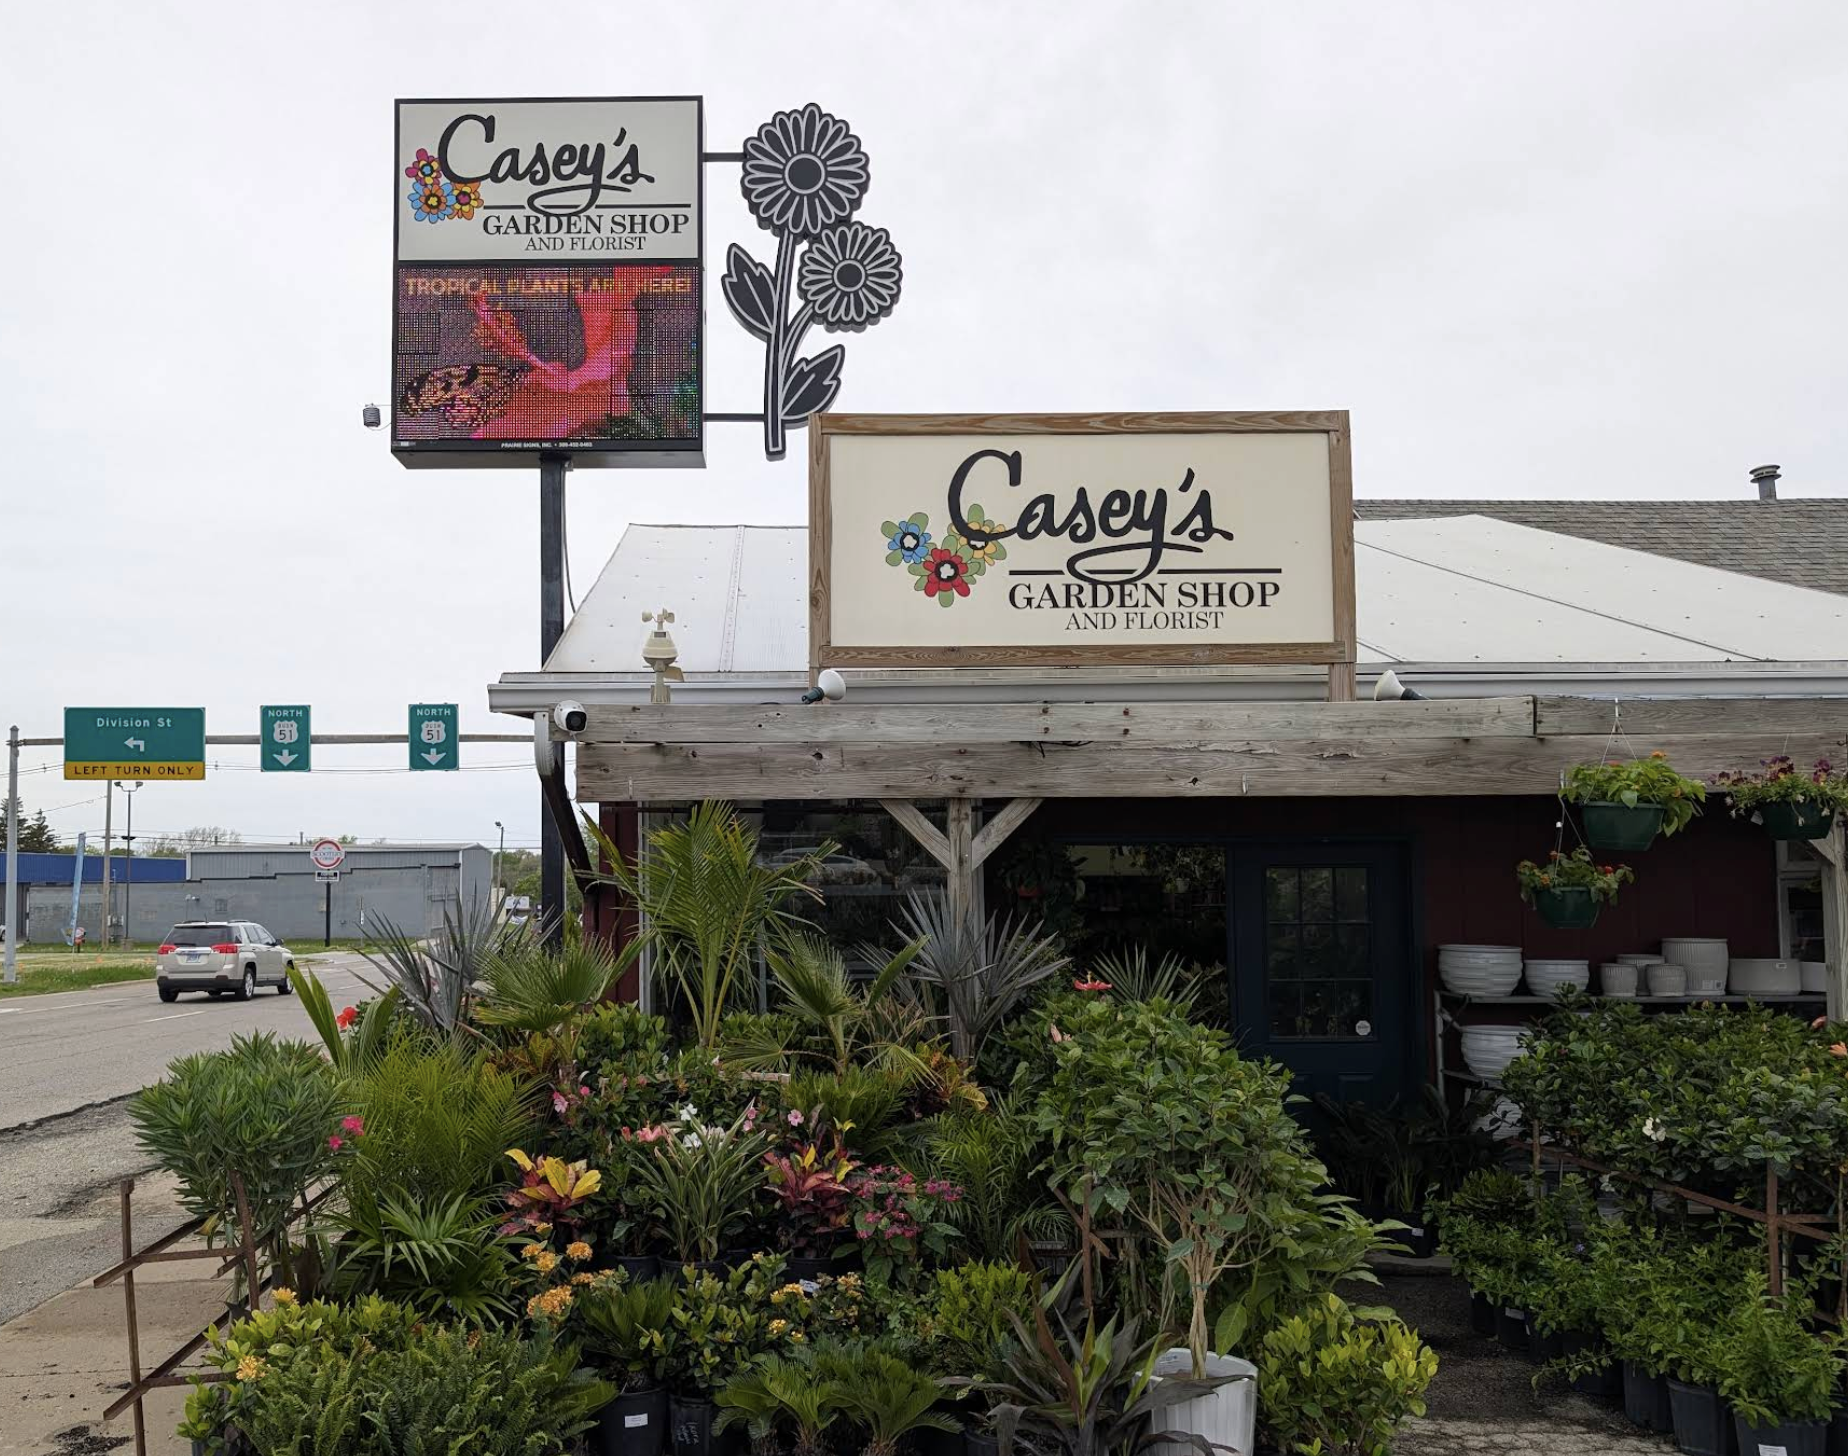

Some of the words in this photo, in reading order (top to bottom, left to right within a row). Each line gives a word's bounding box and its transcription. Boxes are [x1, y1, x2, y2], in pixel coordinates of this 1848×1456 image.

[438, 113, 655, 216] Casey's
[483, 214, 602, 236] GARDEN
[610, 214, 690, 235] SHOP
[525, 237, 565, 251] AND
[569, 236, 647, 251] FLORIST
[405, 277, 503, 296] TROPICAL
[507, 277, 584, 295] PLANTS
[947, 448, 1234, 585] Casey's
[1009, 582, 1167, 610] GARDEN
[1177, 581, 1281, 608] SHOP
[1065, 612, 1117, 631] AND
[1124, 611, 1225, 630] FLORIST
[268, 709, 303, 717] NORTH
[416, 708, 451, 716] NORTH
[96, 717, 150, 728] Division
[157, 717, 172, 728] St
[279, 729, 293, 741] 51
[427, 729, 440, 741] 51
[74, 765, 107, 775] LEFT
[115, 765, 151, 775] TURN
[157, 765, 194, 775] ONLY
